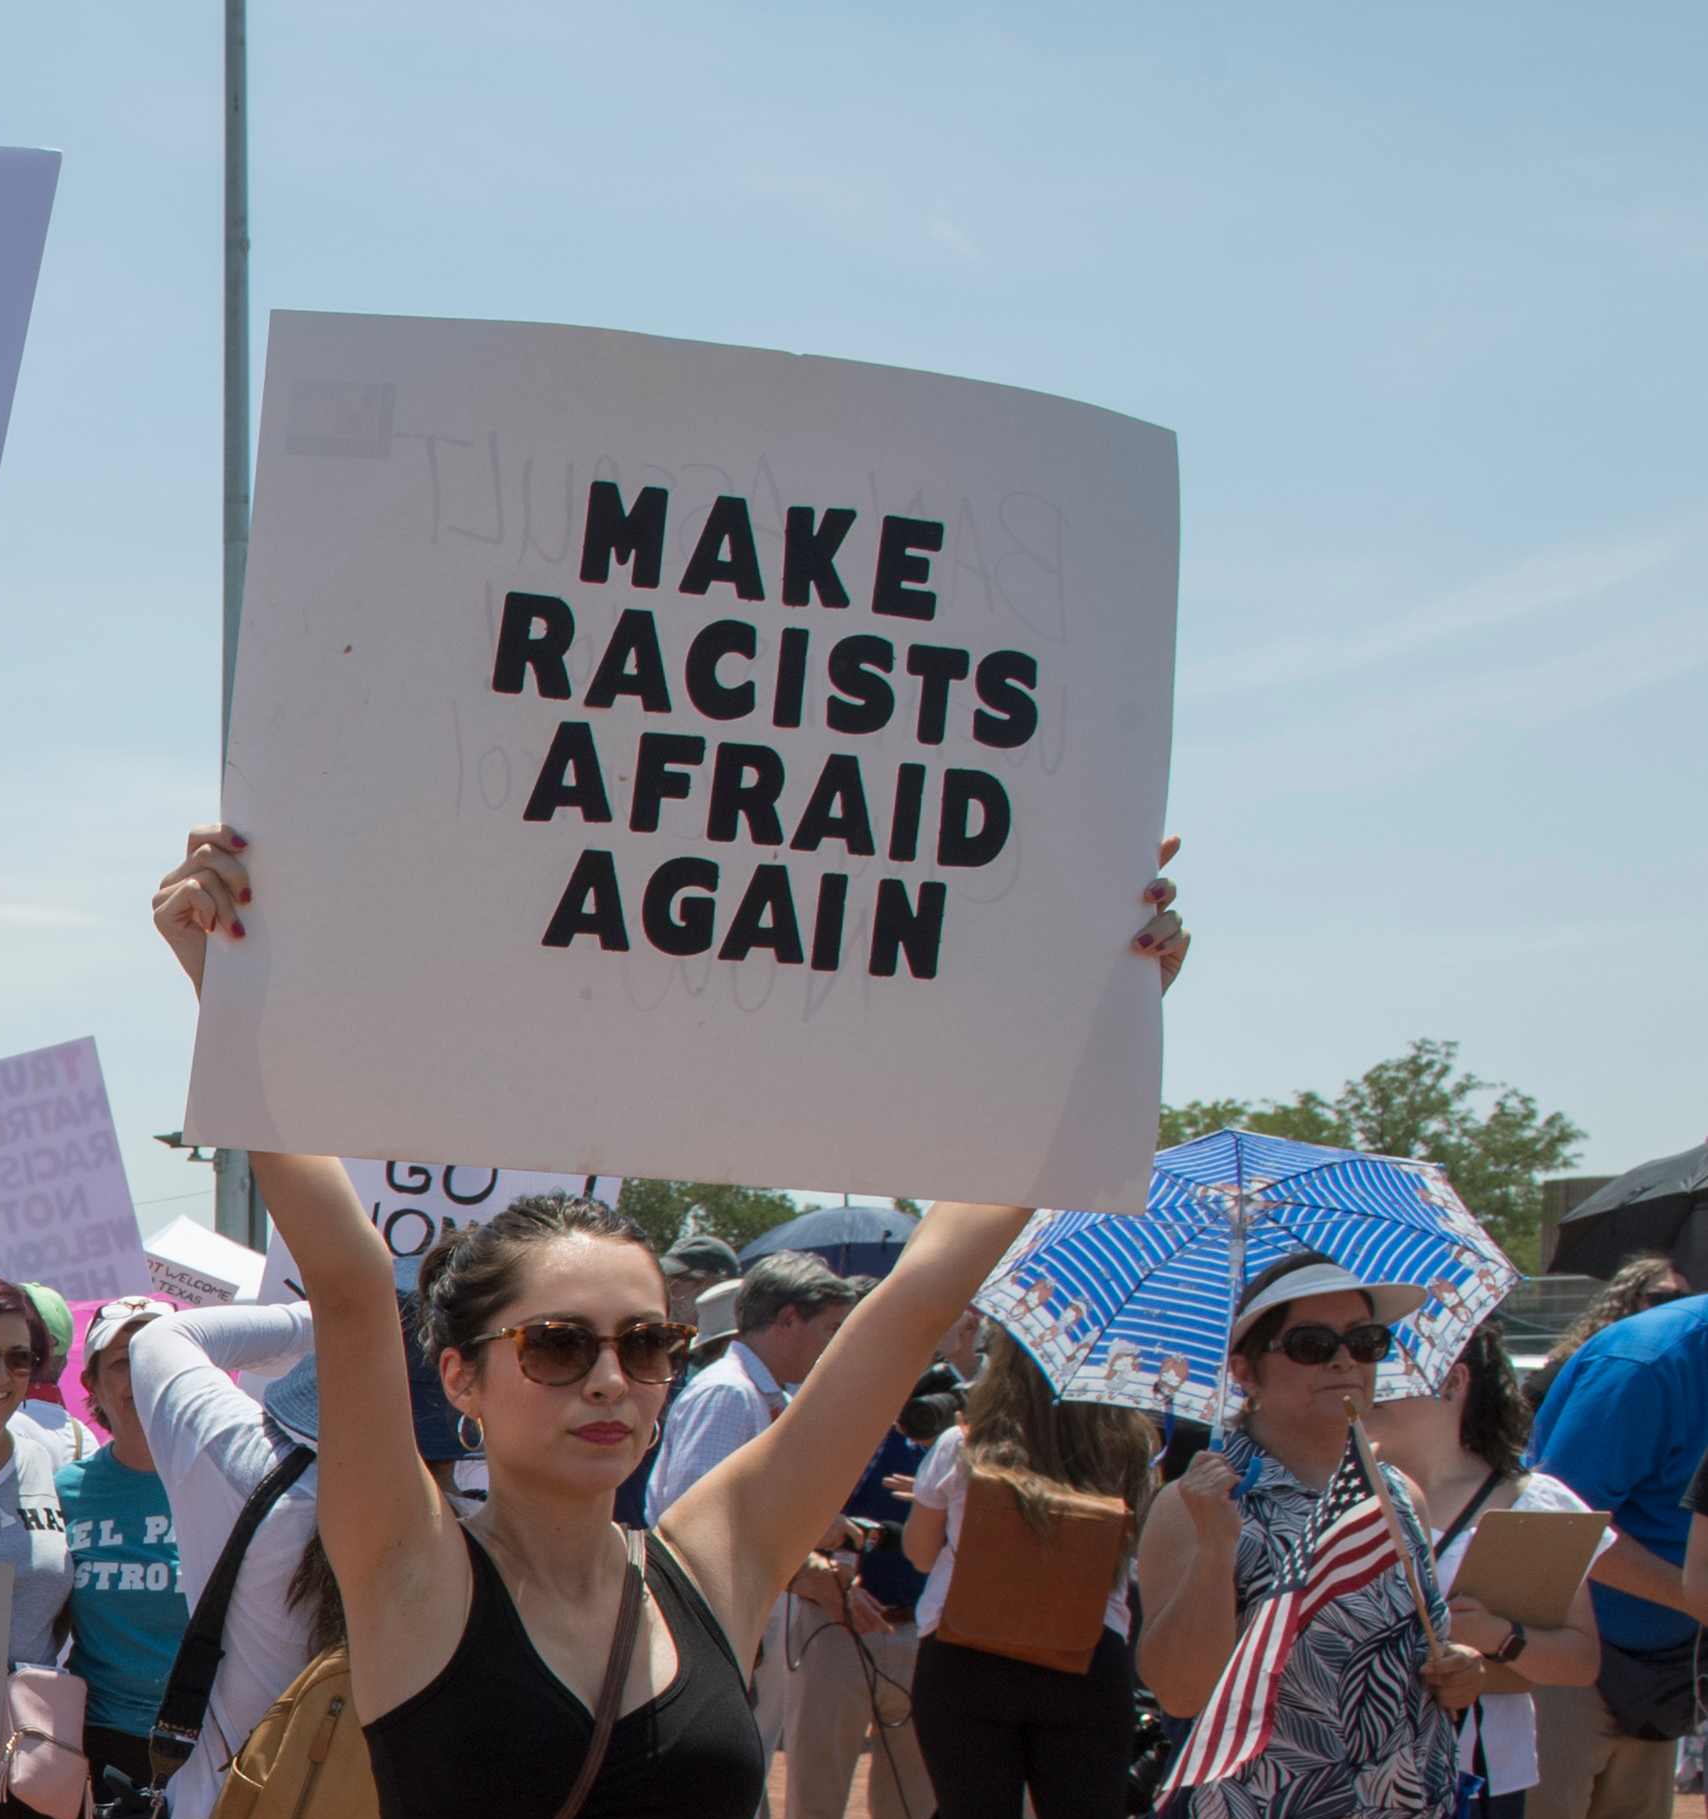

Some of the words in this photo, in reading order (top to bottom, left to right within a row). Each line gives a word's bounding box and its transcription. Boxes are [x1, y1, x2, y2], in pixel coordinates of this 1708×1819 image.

[580, 480, 944, 621] MAKE
[491, 590, 1039, 749] RACISTS
[523, 721, 1012, 867] AFRAID
[541, 850, 947, 980] AGAIN
[166, 1266, 232, 1300] WELCOME
[17, 1507, 65, 1532] HA
[69, 1519, 123, 1549] EL
[73, 1561, 184, 1593] STRO
